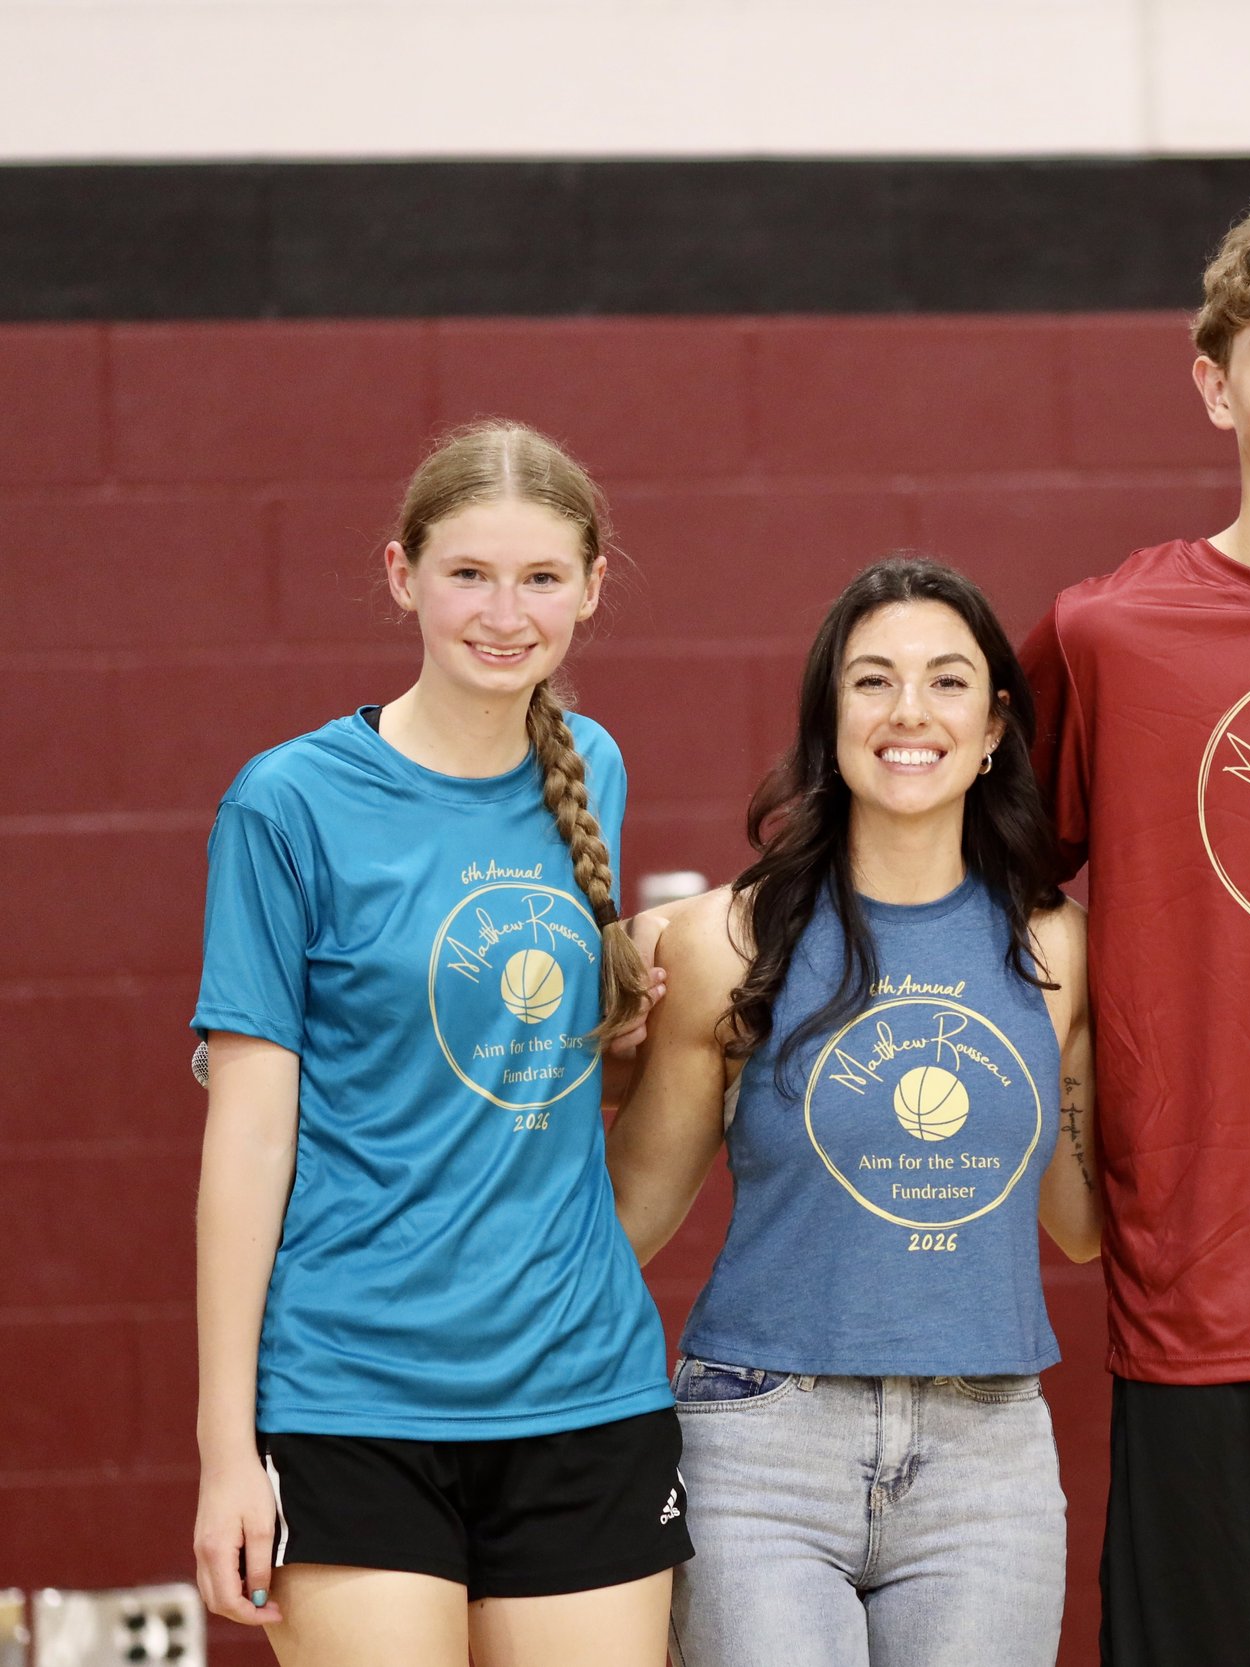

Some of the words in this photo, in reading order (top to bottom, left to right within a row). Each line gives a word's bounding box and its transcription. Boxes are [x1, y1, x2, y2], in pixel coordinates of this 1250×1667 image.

[461, 862, 485, 884] 6th
[485, 859, 543, 881] Annual
[447, 907, 525, 983] Matthew
[521, 893, 595, 964] Rousseau
[896, 974, 966, 998] Annual
[473, 1044, 504, 1059] Aim
[510, 1039, 525, 1055] for
[529, 1036, 553, 1052] the
[830, 1020, 928, 1095] Matthew
[931, 1012, 1012, 1088] Rousseau
[513, 1112, 550, 1132] 2026
[859, 1154, 892, 1170] Aim
[899, 1153, 922, 1169] for
[928, 1153, 954, 1169] the
[960, 1153, 1000, 1169] Stars
[892, 1184, 976, 1200] Fundraiser
[908, 1233, 958, 1252] 2026
